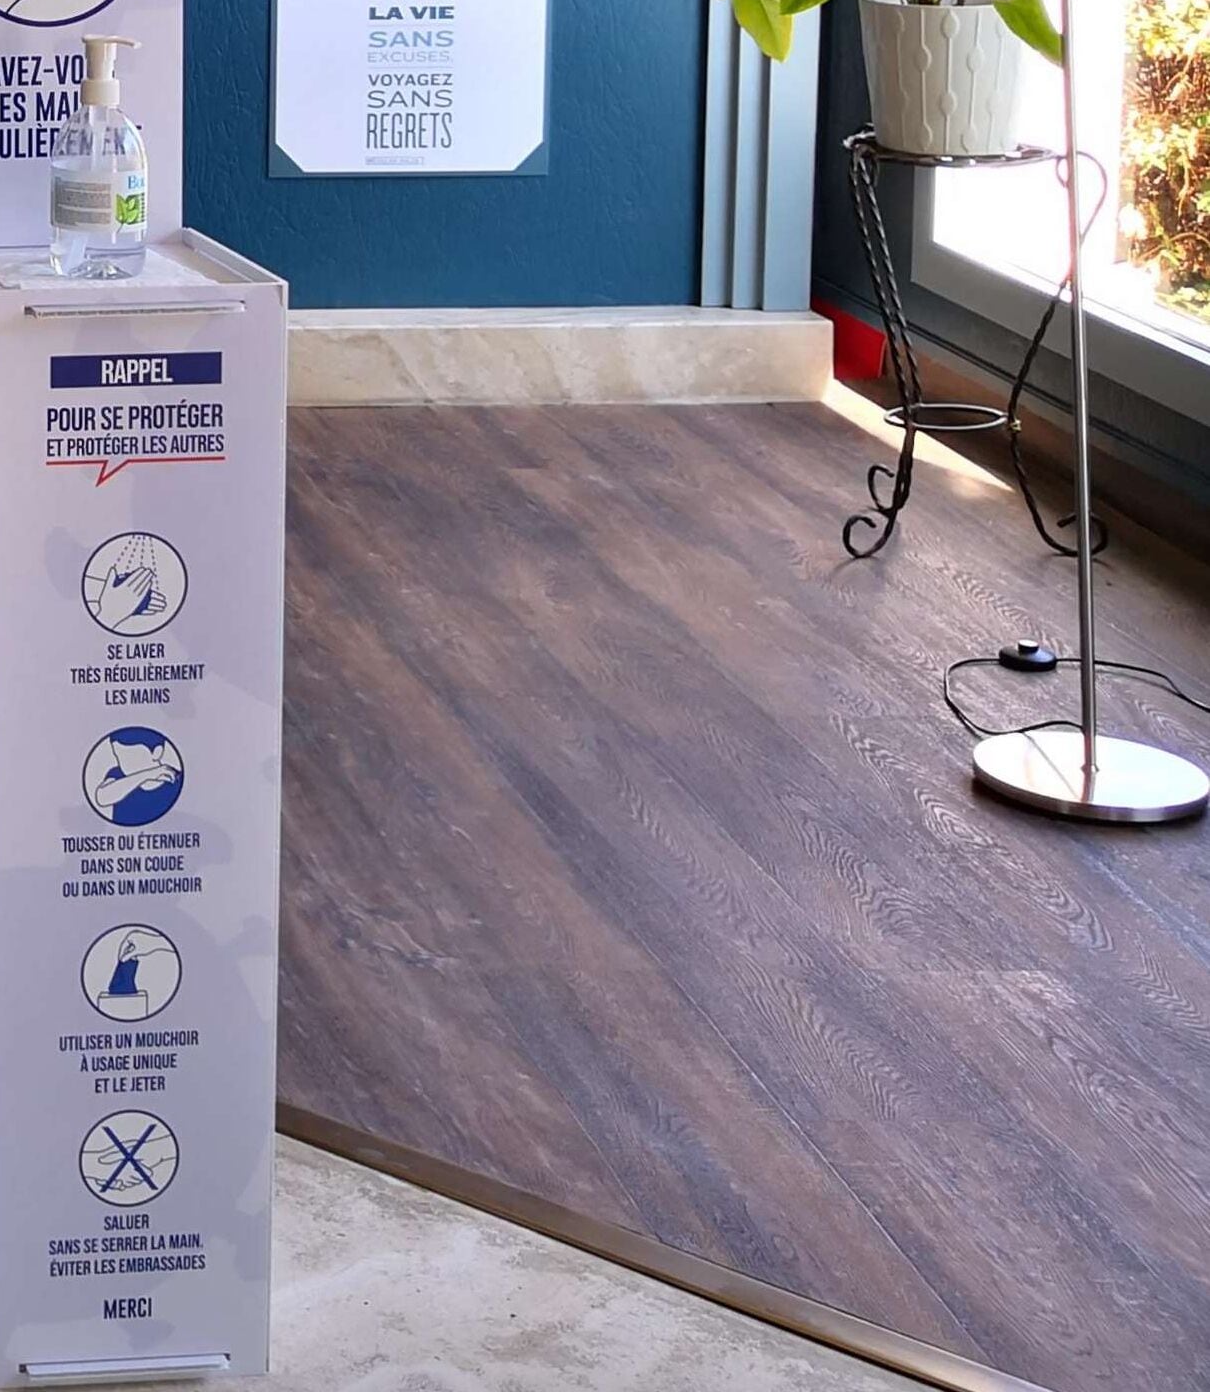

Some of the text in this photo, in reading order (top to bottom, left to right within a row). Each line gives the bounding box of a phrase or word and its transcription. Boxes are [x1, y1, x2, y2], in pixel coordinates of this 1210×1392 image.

[368, 6, 455, 20] LA VIE
[368, 30, 454, 48] SANS
[368, 73, 453, 86] VOYAGEZ
[36, 90, 80, 123] MAI
[367, 89, 453, 109] SANS
[366, 112, 453, 149] REGRETS
[101, 358, 174, 384] RAPPEL
[46, 399, 224, 432] POUR SE PROTÉGER
[46, 433, 225, 457] ET PROTÉGER LES AUTRES
[107, 643, 165, 660] SE LAVER
[70, 662, 205, 684] TRÈS RÉGULIÈREMENT
[105, 688, 170, 705] LES MAINS
[62, 831, 201, 853] TOUSSER OU ÉTERNUER
[80, 856, 184, 875] DANS SON COUDE
[62, 877, 202, 898] OU DANS UN MOUCHOIR
[59, 1031, 199, 1051] UTILISER UN MOUCHOIR
[80, 1053, 177, 1072] À USAGE UNIQUE
[94, 1076, 165, 1093] ET LE JETER
[103, 1214, 150, 1231] SALUER
[49, 1240, 81, 1256] SANS
[83, 1239, 99, 1254] SE
[101, 1236, 148, 1253] SERRER
[150, 1236, 166, 1251] LA
[49, 1254, 206, 1277] ÉVITER LES EMBRASSADES
[103, 1298, 153, 1320] MERCI
